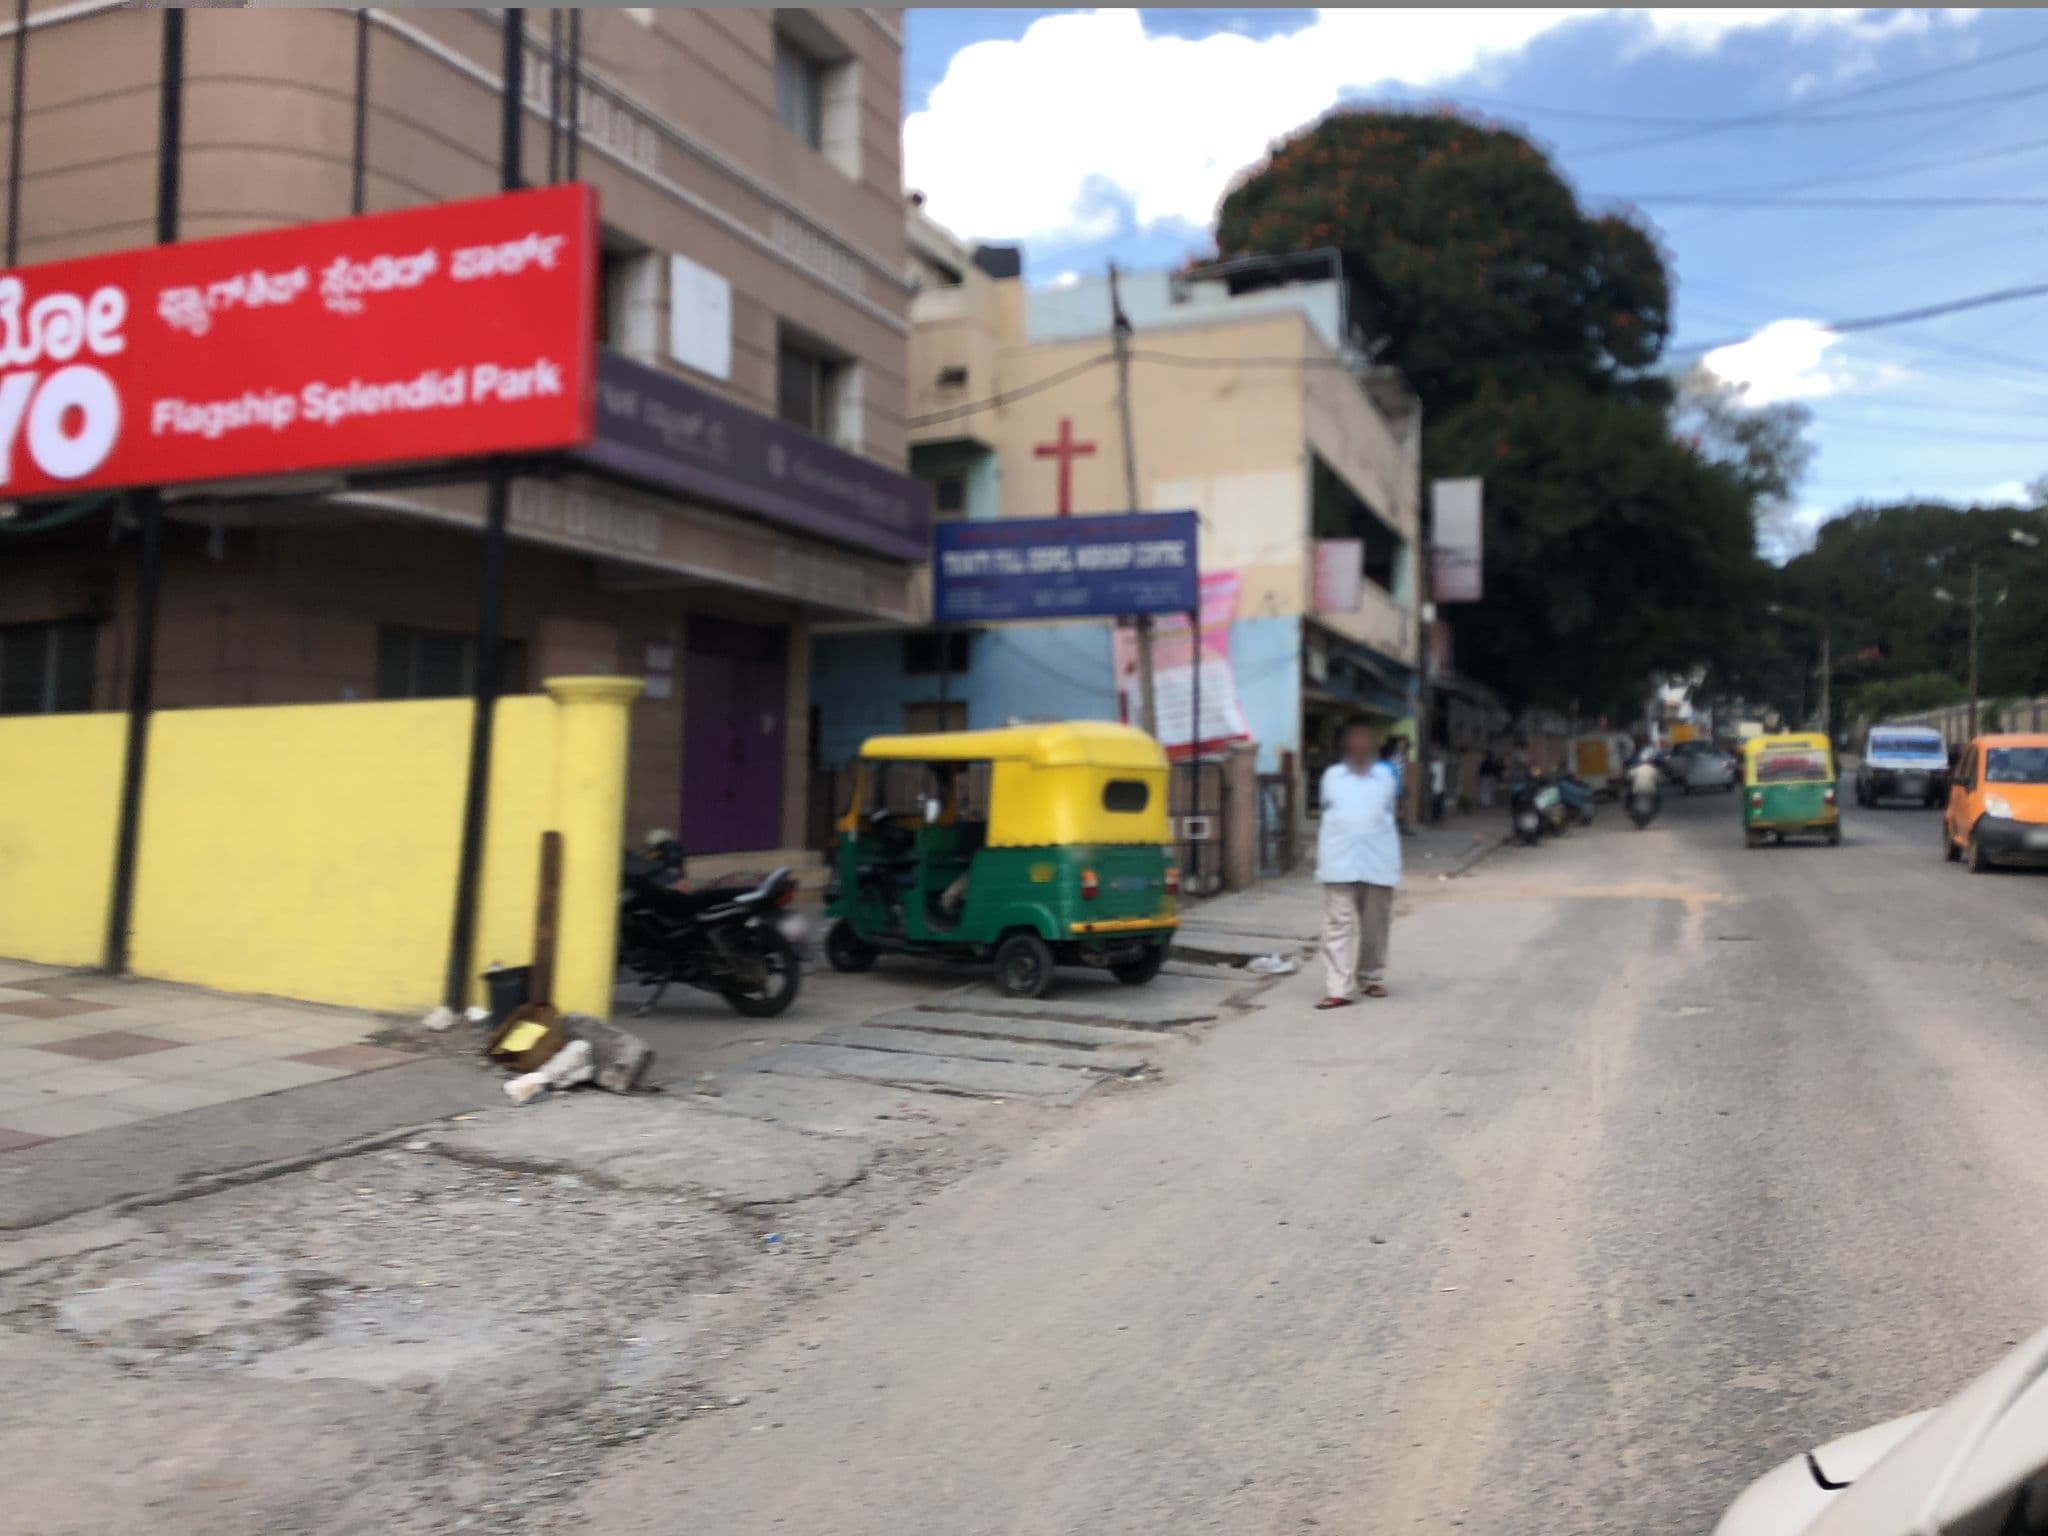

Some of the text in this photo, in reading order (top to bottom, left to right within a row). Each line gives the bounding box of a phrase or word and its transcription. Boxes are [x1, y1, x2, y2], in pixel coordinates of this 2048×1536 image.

[151, 359, 562, 438] Flagship Splendid Park
